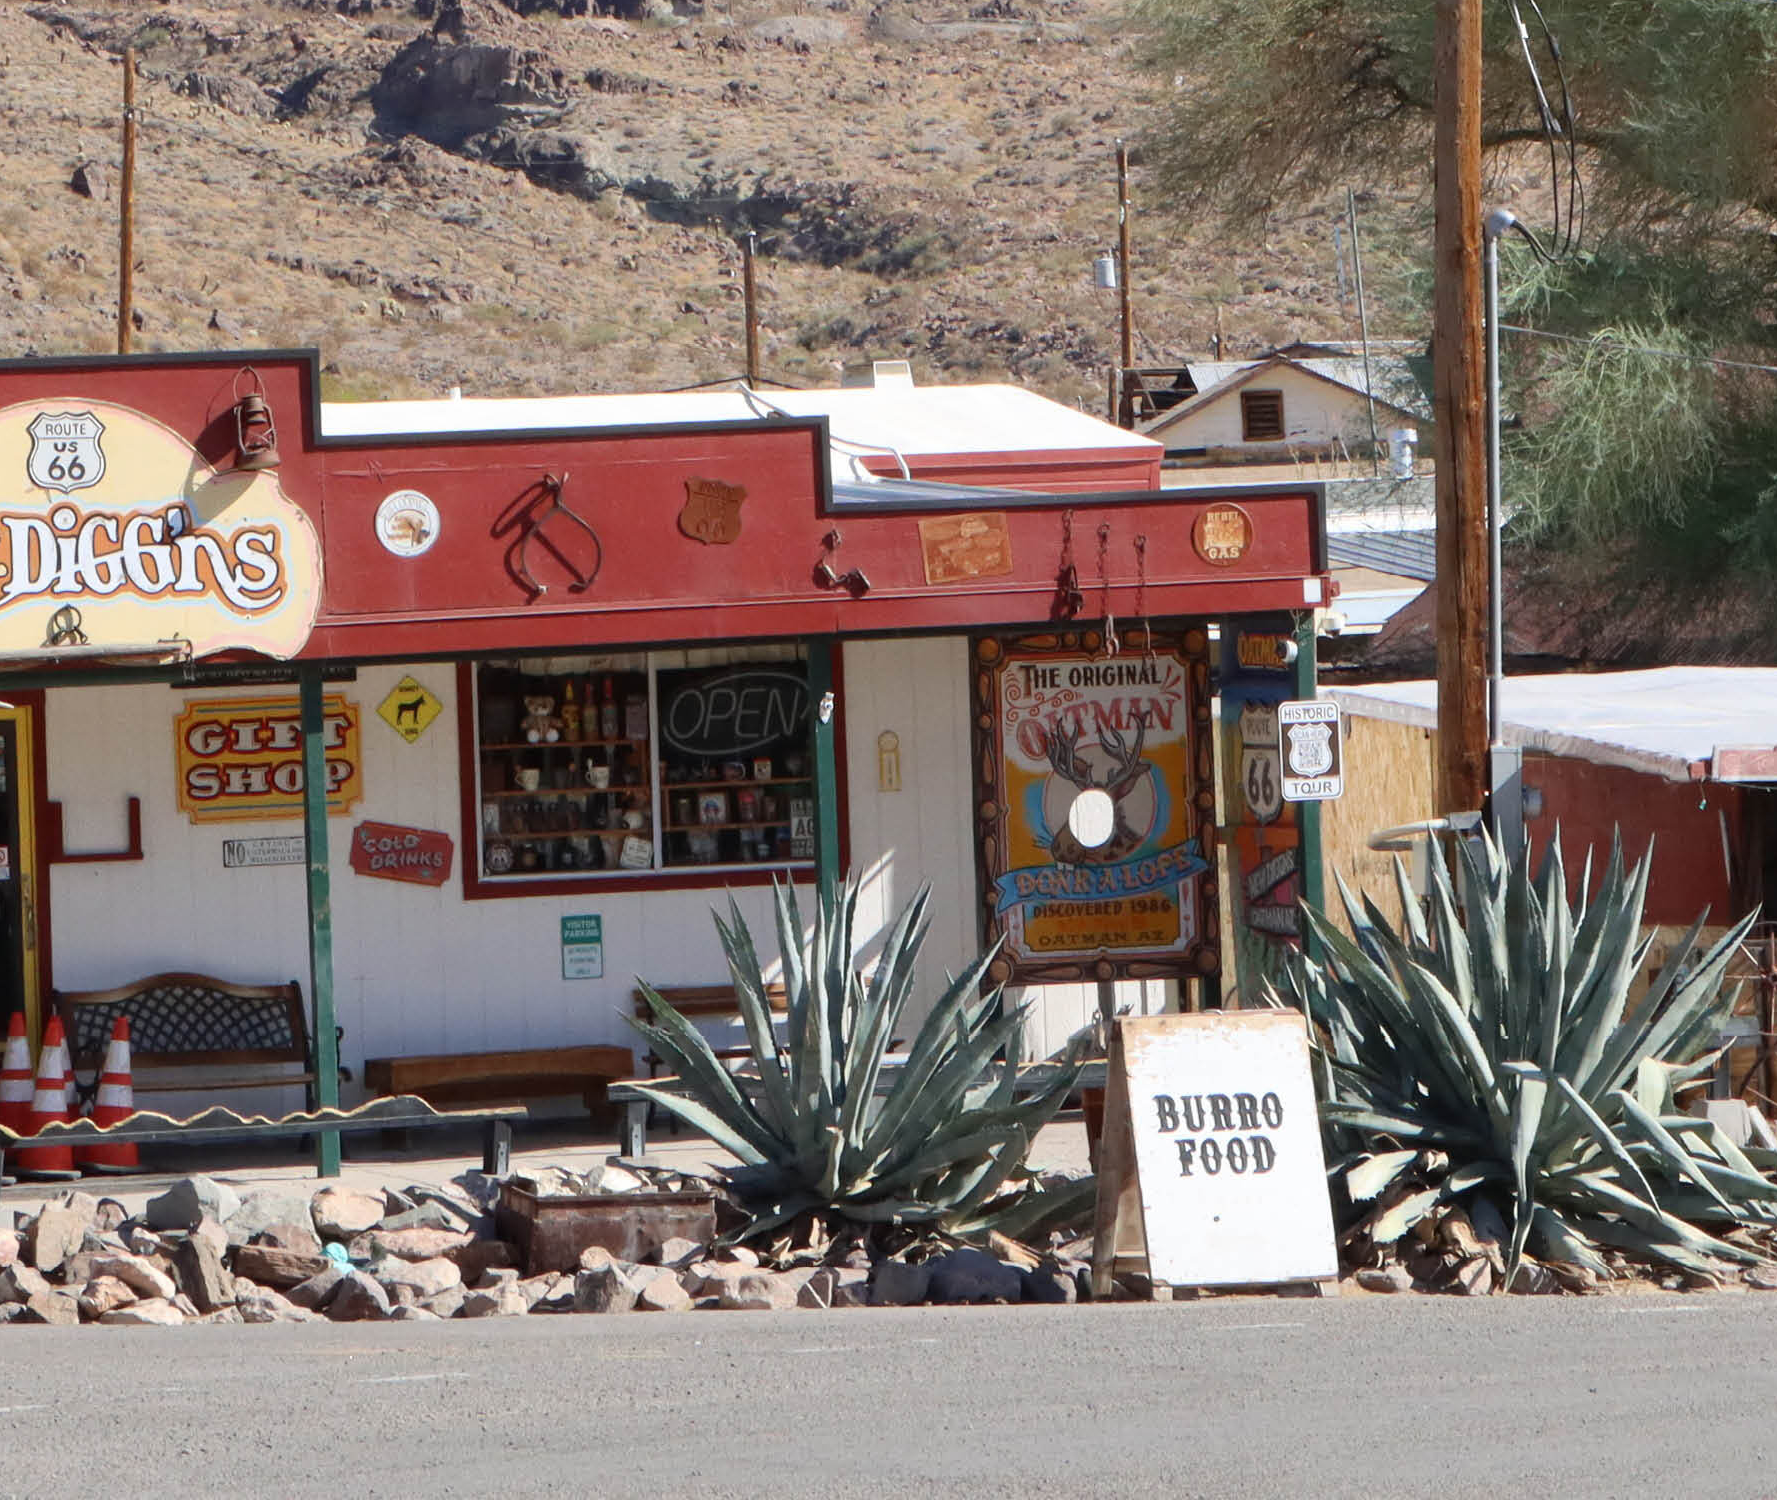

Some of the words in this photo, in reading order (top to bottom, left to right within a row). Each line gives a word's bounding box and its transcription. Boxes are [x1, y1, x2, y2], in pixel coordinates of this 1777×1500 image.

[45, 422, 87, 436] ROUTE
[53, 440, 78, 453] US
[47, 455, 86, 481] 66
[1208, 547, 1240, 559] GAS
[1020, 664, 1061, 698] THE
[1069, 665, 1162, 688] ORIGINAL
[669, 687, 800, 740] OPEN
[1284, 706, 1335, 720] HISTORIC
[186, 713, 354, 758] GIFT
[1016, 698, 1175, 760] OATMAN
[186, 758, 355, 800] SHOP
[1248, 757, 1275, 806] 66
[1292, 781, 1333, 795] TOUR
[226, 841, 246, 867] NO
[362, 834, 421, 853] COLD
[370, 851, 444, 869] DRINKS
[1033, 902, 1122, 918] DISCOVERED
[1130, 899, 1171, 914] 1986
[1038, 931, 1128, 947] OATMAN
[1156, 1090, 1284, 1134] BURRO
[1178, 1135, 1278, 1178] FOOD
